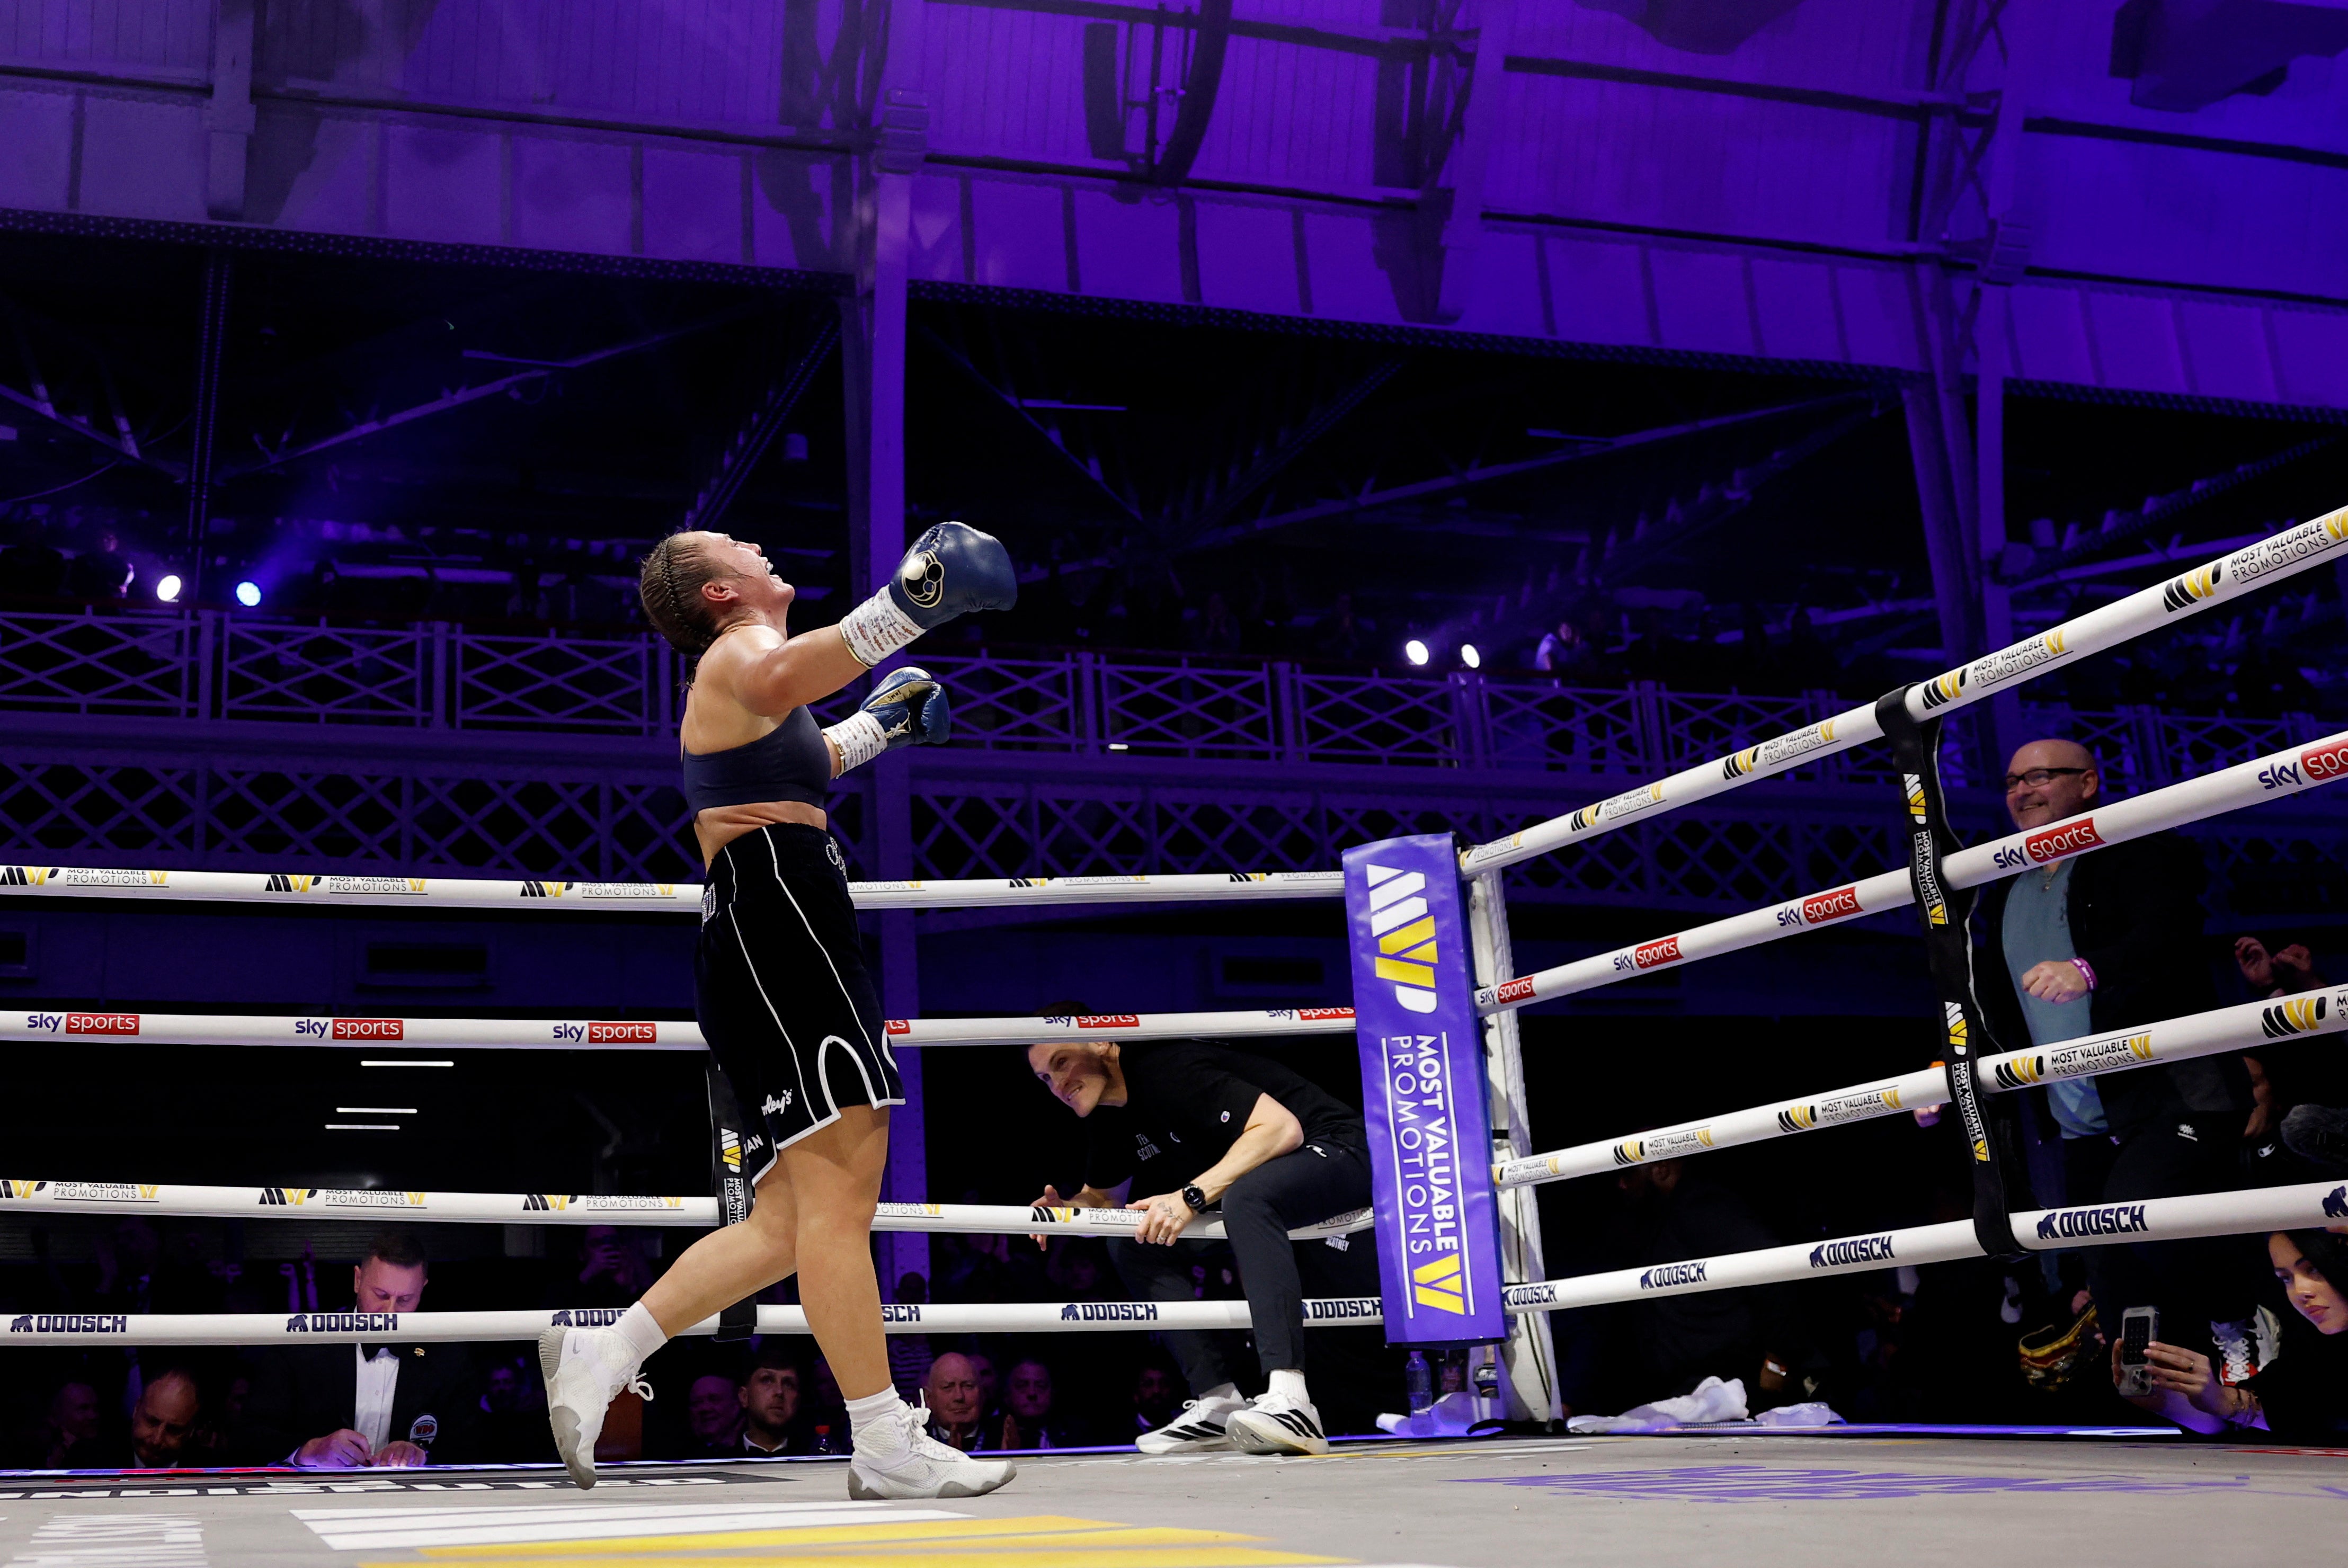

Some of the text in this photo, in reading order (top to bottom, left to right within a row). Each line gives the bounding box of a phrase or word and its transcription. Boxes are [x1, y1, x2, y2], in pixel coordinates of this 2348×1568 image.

[2231, 522, 2323, 568] MOST VALUABLE
[2231, 534, 2329, 581] PROMOTIONS
[1973, 637, 2044, 674] MOST VALUABLE
[1974, 648, 2049, 685] PROMOTIONS
[1764, 725, 1820, 752] MOST VALUABLE
[1764, 735, 1821, 763] PROMOTIONS
[2258, 762, 2302, 790] sky
[1604, 794, 1651, 816] PROMOTIONS
[1474, 841, 1512, 859] PROMOTIONS
[1993, 826, 2095, 869] sky sports
[67, 875, 147, 884] PROMOTIONS
[1916, 832, 1935, 907] PROMOTIONS
[1921, 830, 1942, 905] MOST VALUABLE
[329, 883, 406, 891] PROMOTIONS
[582, 887, 656, 895] PROMOTIONS
[1777, 893, 1855, 926] sky sports
[1614, 941, 1677, 970] sky sports
[1480, 980, 1531, 1004] sky sports
[28, 1013, 137, 1032] sky sports
[296, 1019, 400, 1038] sky sports
[553, 1023, 653, 1043] sky sports
[2051, 1039, 2128, 1065] MOST VALUABLE
[2053, 1053, 2136, 1076] PROMOTIONS
[1821, 1093, 1882, 1115] MOST VALUABLE
[1824, 1103, 1889, 1123] PROMOTIONS
[1953, 1064, 1977, 1142] PROMOTIONS
[1960, 1063, 1984, 1141] MOST VALUABLE
[1391, 1036, 1433, 1254] PROMOTIONS
[1416, 1035, 1459, 1252] MOST VALUABLE
[1649, 1132, 1697, 1148] MOST VALUABLE
[1508, 1159, 1547, 1172] MOST VALUABLE
[54, 1188, 137, 1199] PROMOTIONS
[325, 1195, 405, 1205] PROMOTIONS
[733, 1178, 742, 1199] MOST
[726, 1178, 737, 1225] PROMOTIO
[882, 1305, 921, 1322] SCH
